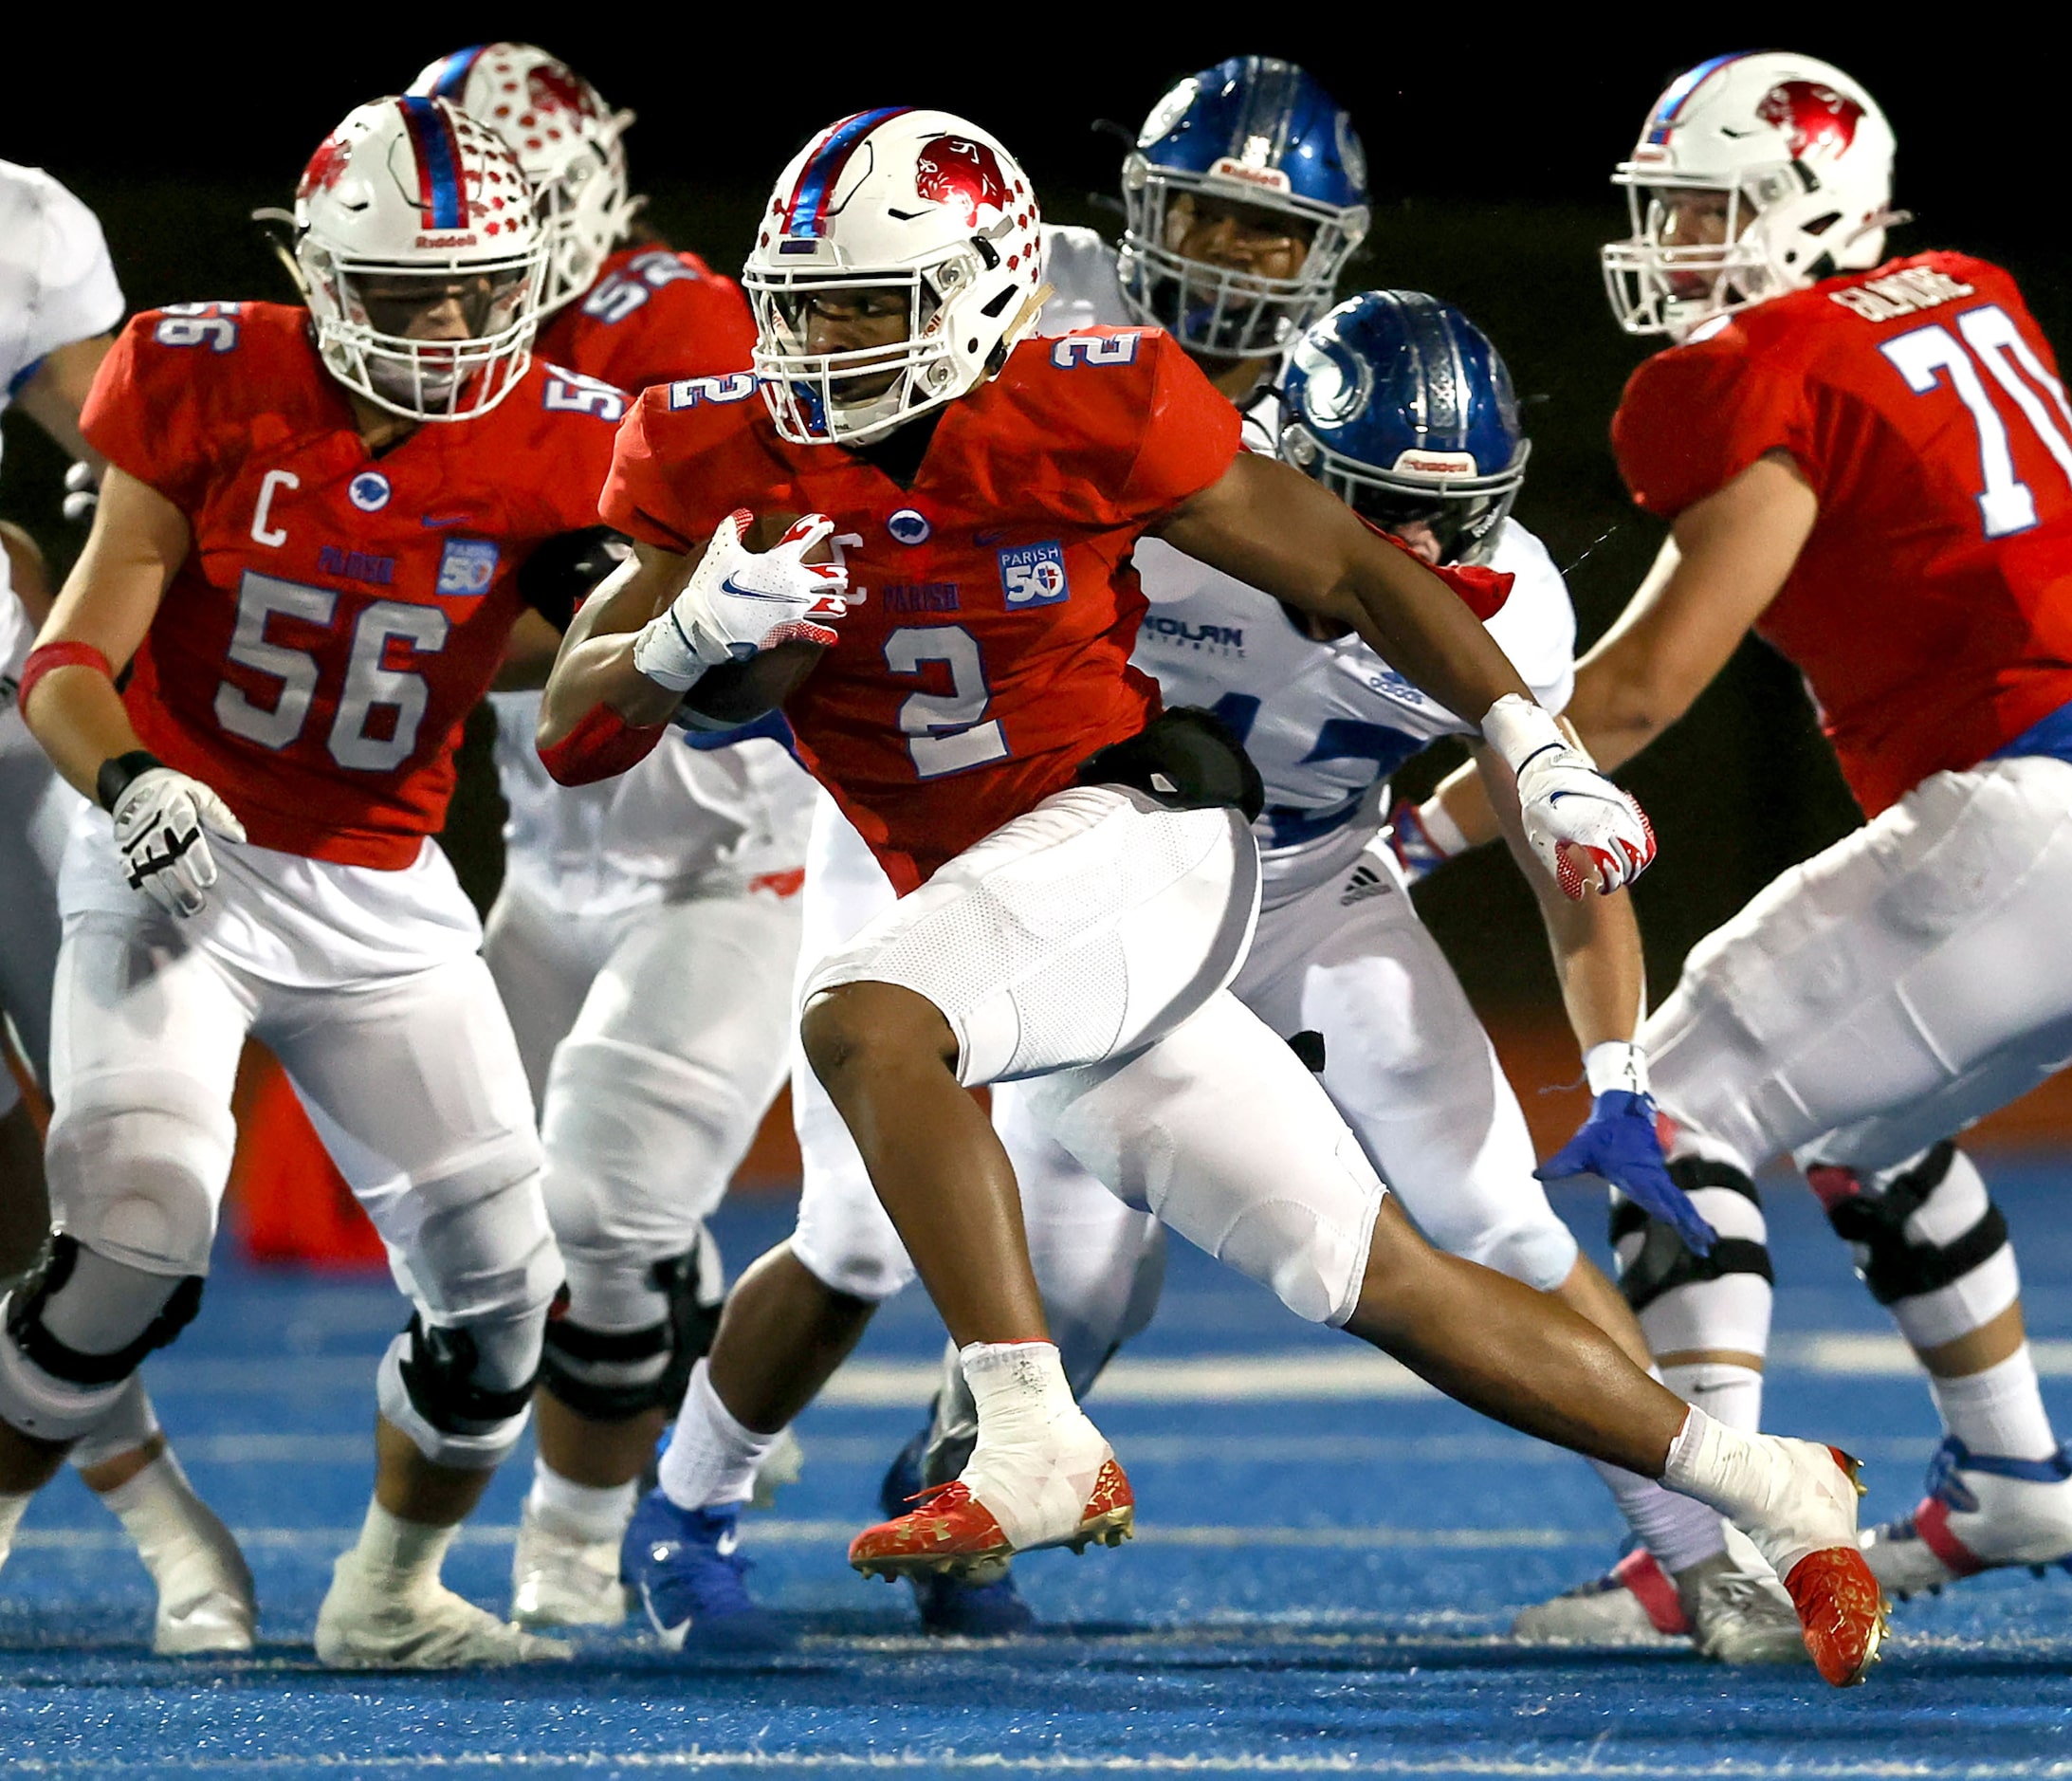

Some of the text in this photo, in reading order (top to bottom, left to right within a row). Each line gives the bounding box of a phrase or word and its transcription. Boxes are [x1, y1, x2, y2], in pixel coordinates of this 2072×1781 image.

[581, 250, 699, 326] 52
[1050, 332, 1141, 371] 2
[669, 374, 759, 412] 2
[1877, 304, 2072, 541] 70
[250, 469, 300, 547] C
[1001, 546, 1059, 566] PARISH
[1006, 560, 1064, 602] 50
[883, 581, 960, 613] PARISH
[213, 570, 449, 772] 56
[882, 623, 1011, 780] 2
